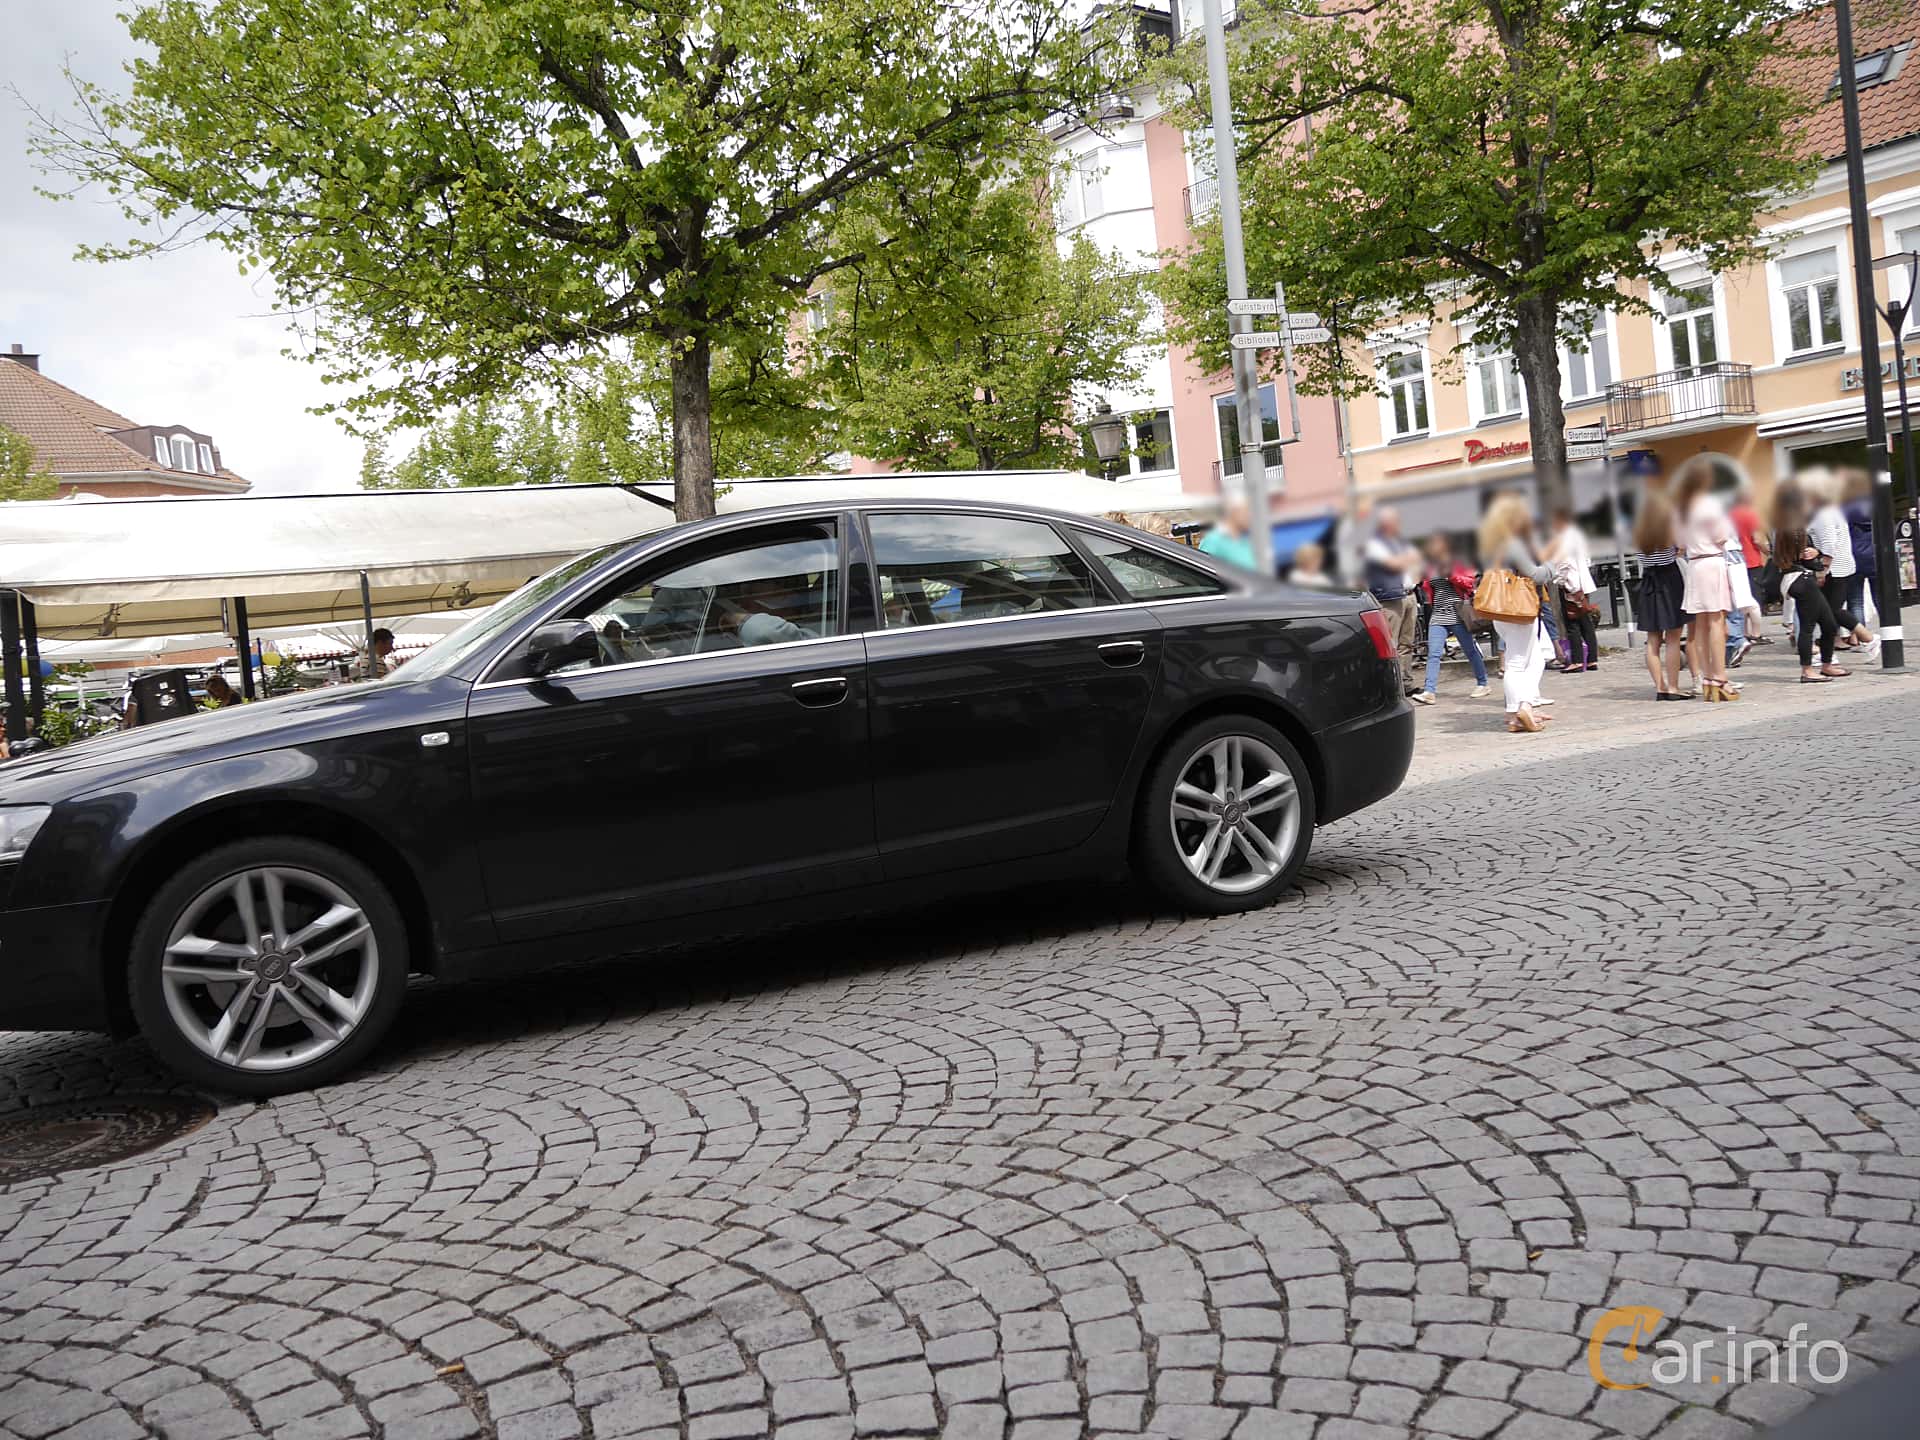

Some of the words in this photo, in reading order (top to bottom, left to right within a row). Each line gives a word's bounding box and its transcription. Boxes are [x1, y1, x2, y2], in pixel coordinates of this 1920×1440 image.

[1233, 303, 1275, 312] Turistbyrå
[1238, 335, 1276, 345] Bibliotek
[1294, 331, 1323, 341] Apotek
[1567, 430, 1601, 441] Stortorget
